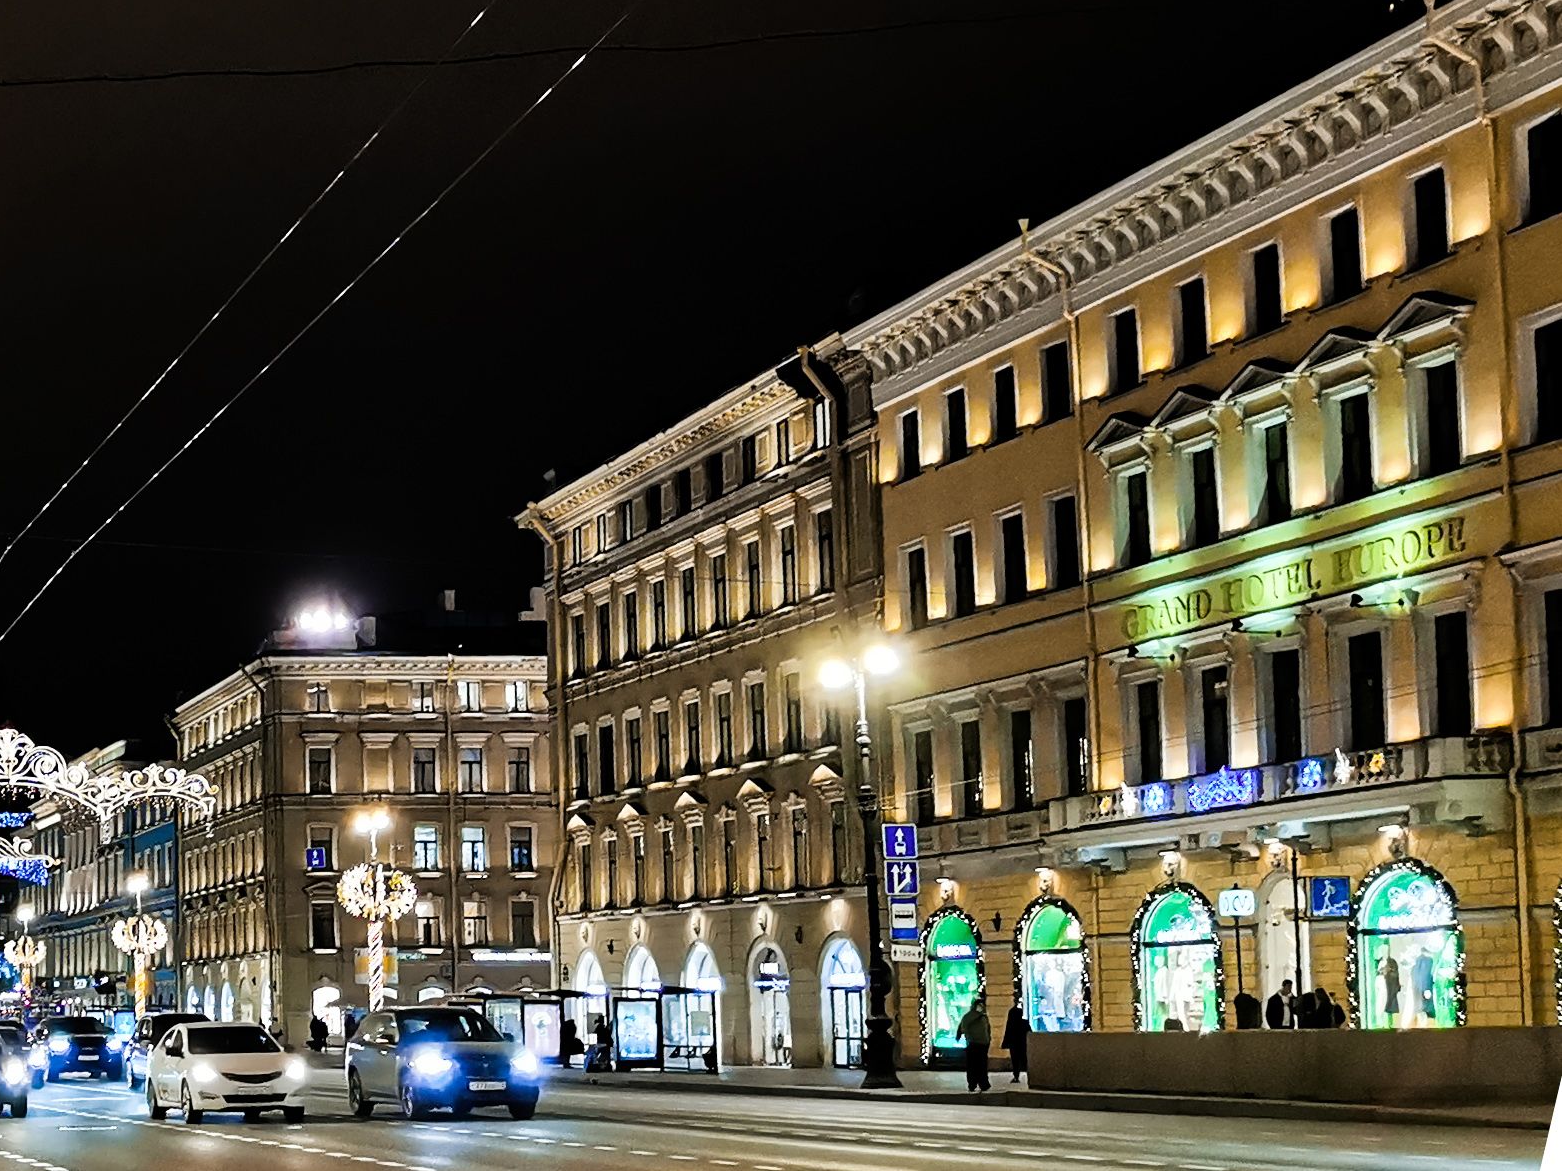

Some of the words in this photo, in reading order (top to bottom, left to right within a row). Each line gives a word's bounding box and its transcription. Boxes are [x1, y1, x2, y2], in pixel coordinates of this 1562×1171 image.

[1121, 590, 1212, 639] GRAND
[1221, 559, 1321, 613] HOTEL
[1332, 516, 1467, 583] EUROPE
